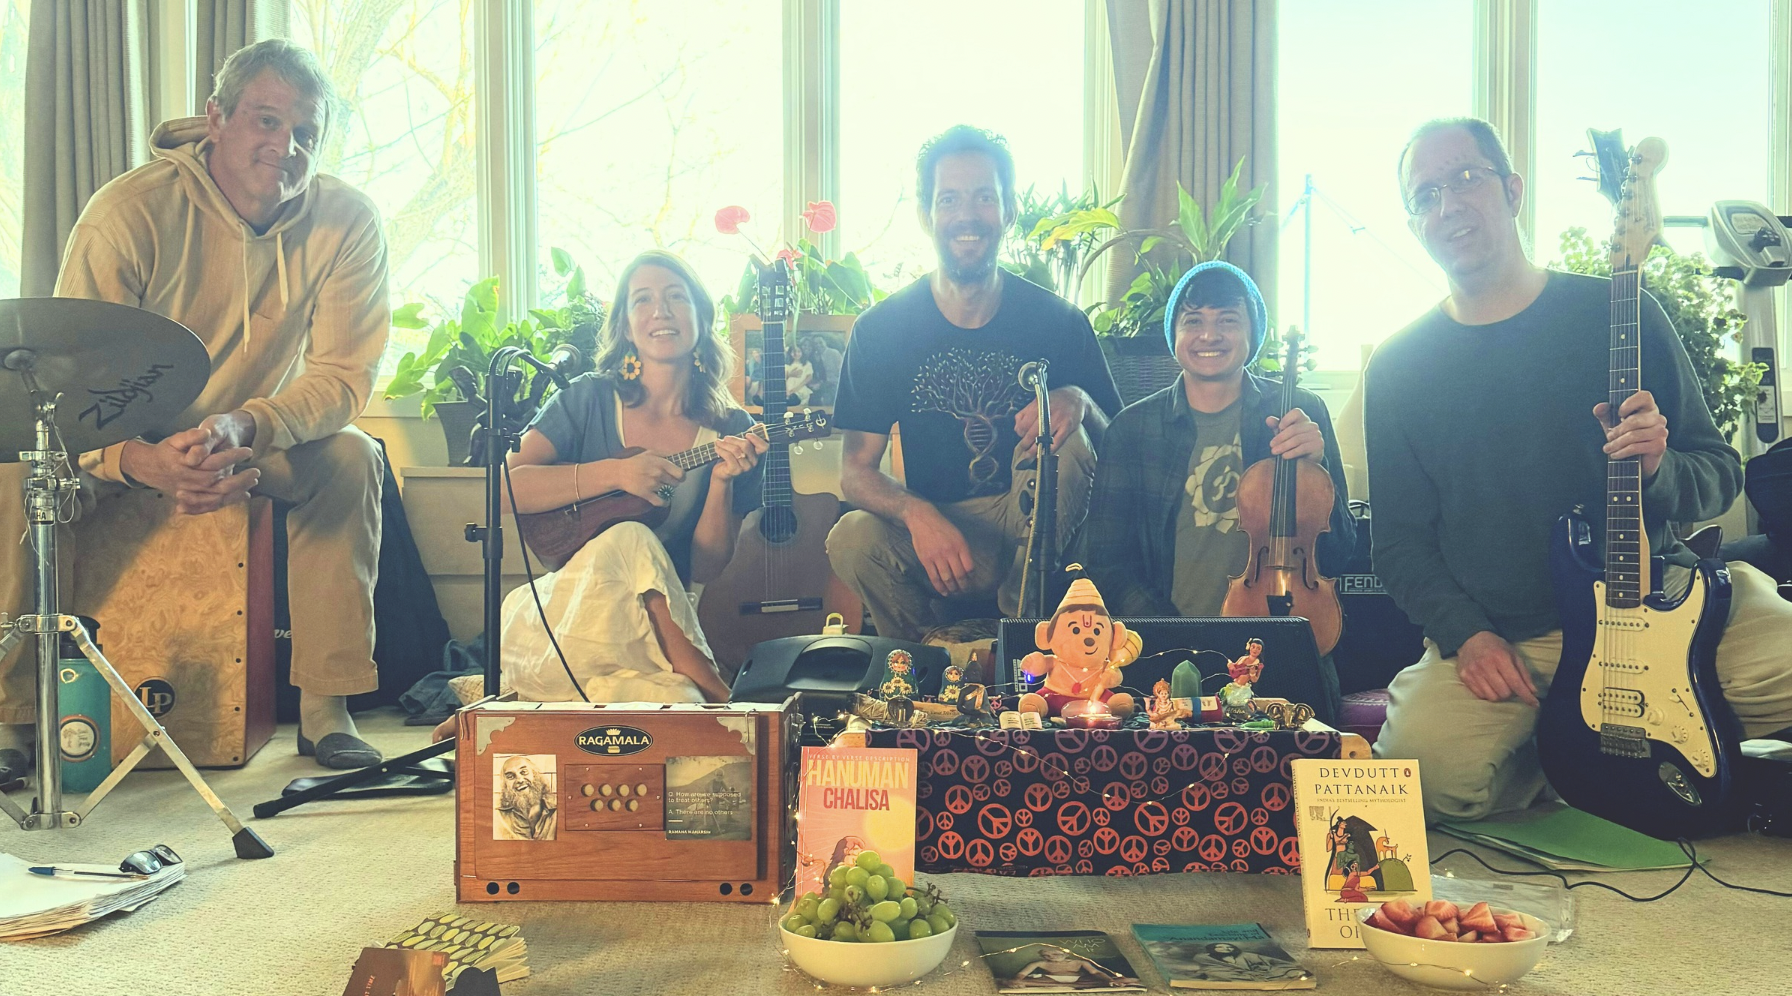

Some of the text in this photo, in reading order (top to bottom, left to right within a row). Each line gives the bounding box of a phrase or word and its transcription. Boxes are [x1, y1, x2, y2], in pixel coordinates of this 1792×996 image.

[78, 364, 174, 430] Zildjian
[1345, 576, 1383, 592] FEND
[140, 686, 173, 714] LP
[579, 736, 650, 746] RAGAMALA
[807, 759, 909, 789] HANUMAN
[1320, 768, 1399, 778] DEVDUTT
[823, 787, 890, 811] CHALISA
[1315, 784, 1408, 795] PATTANAIK
